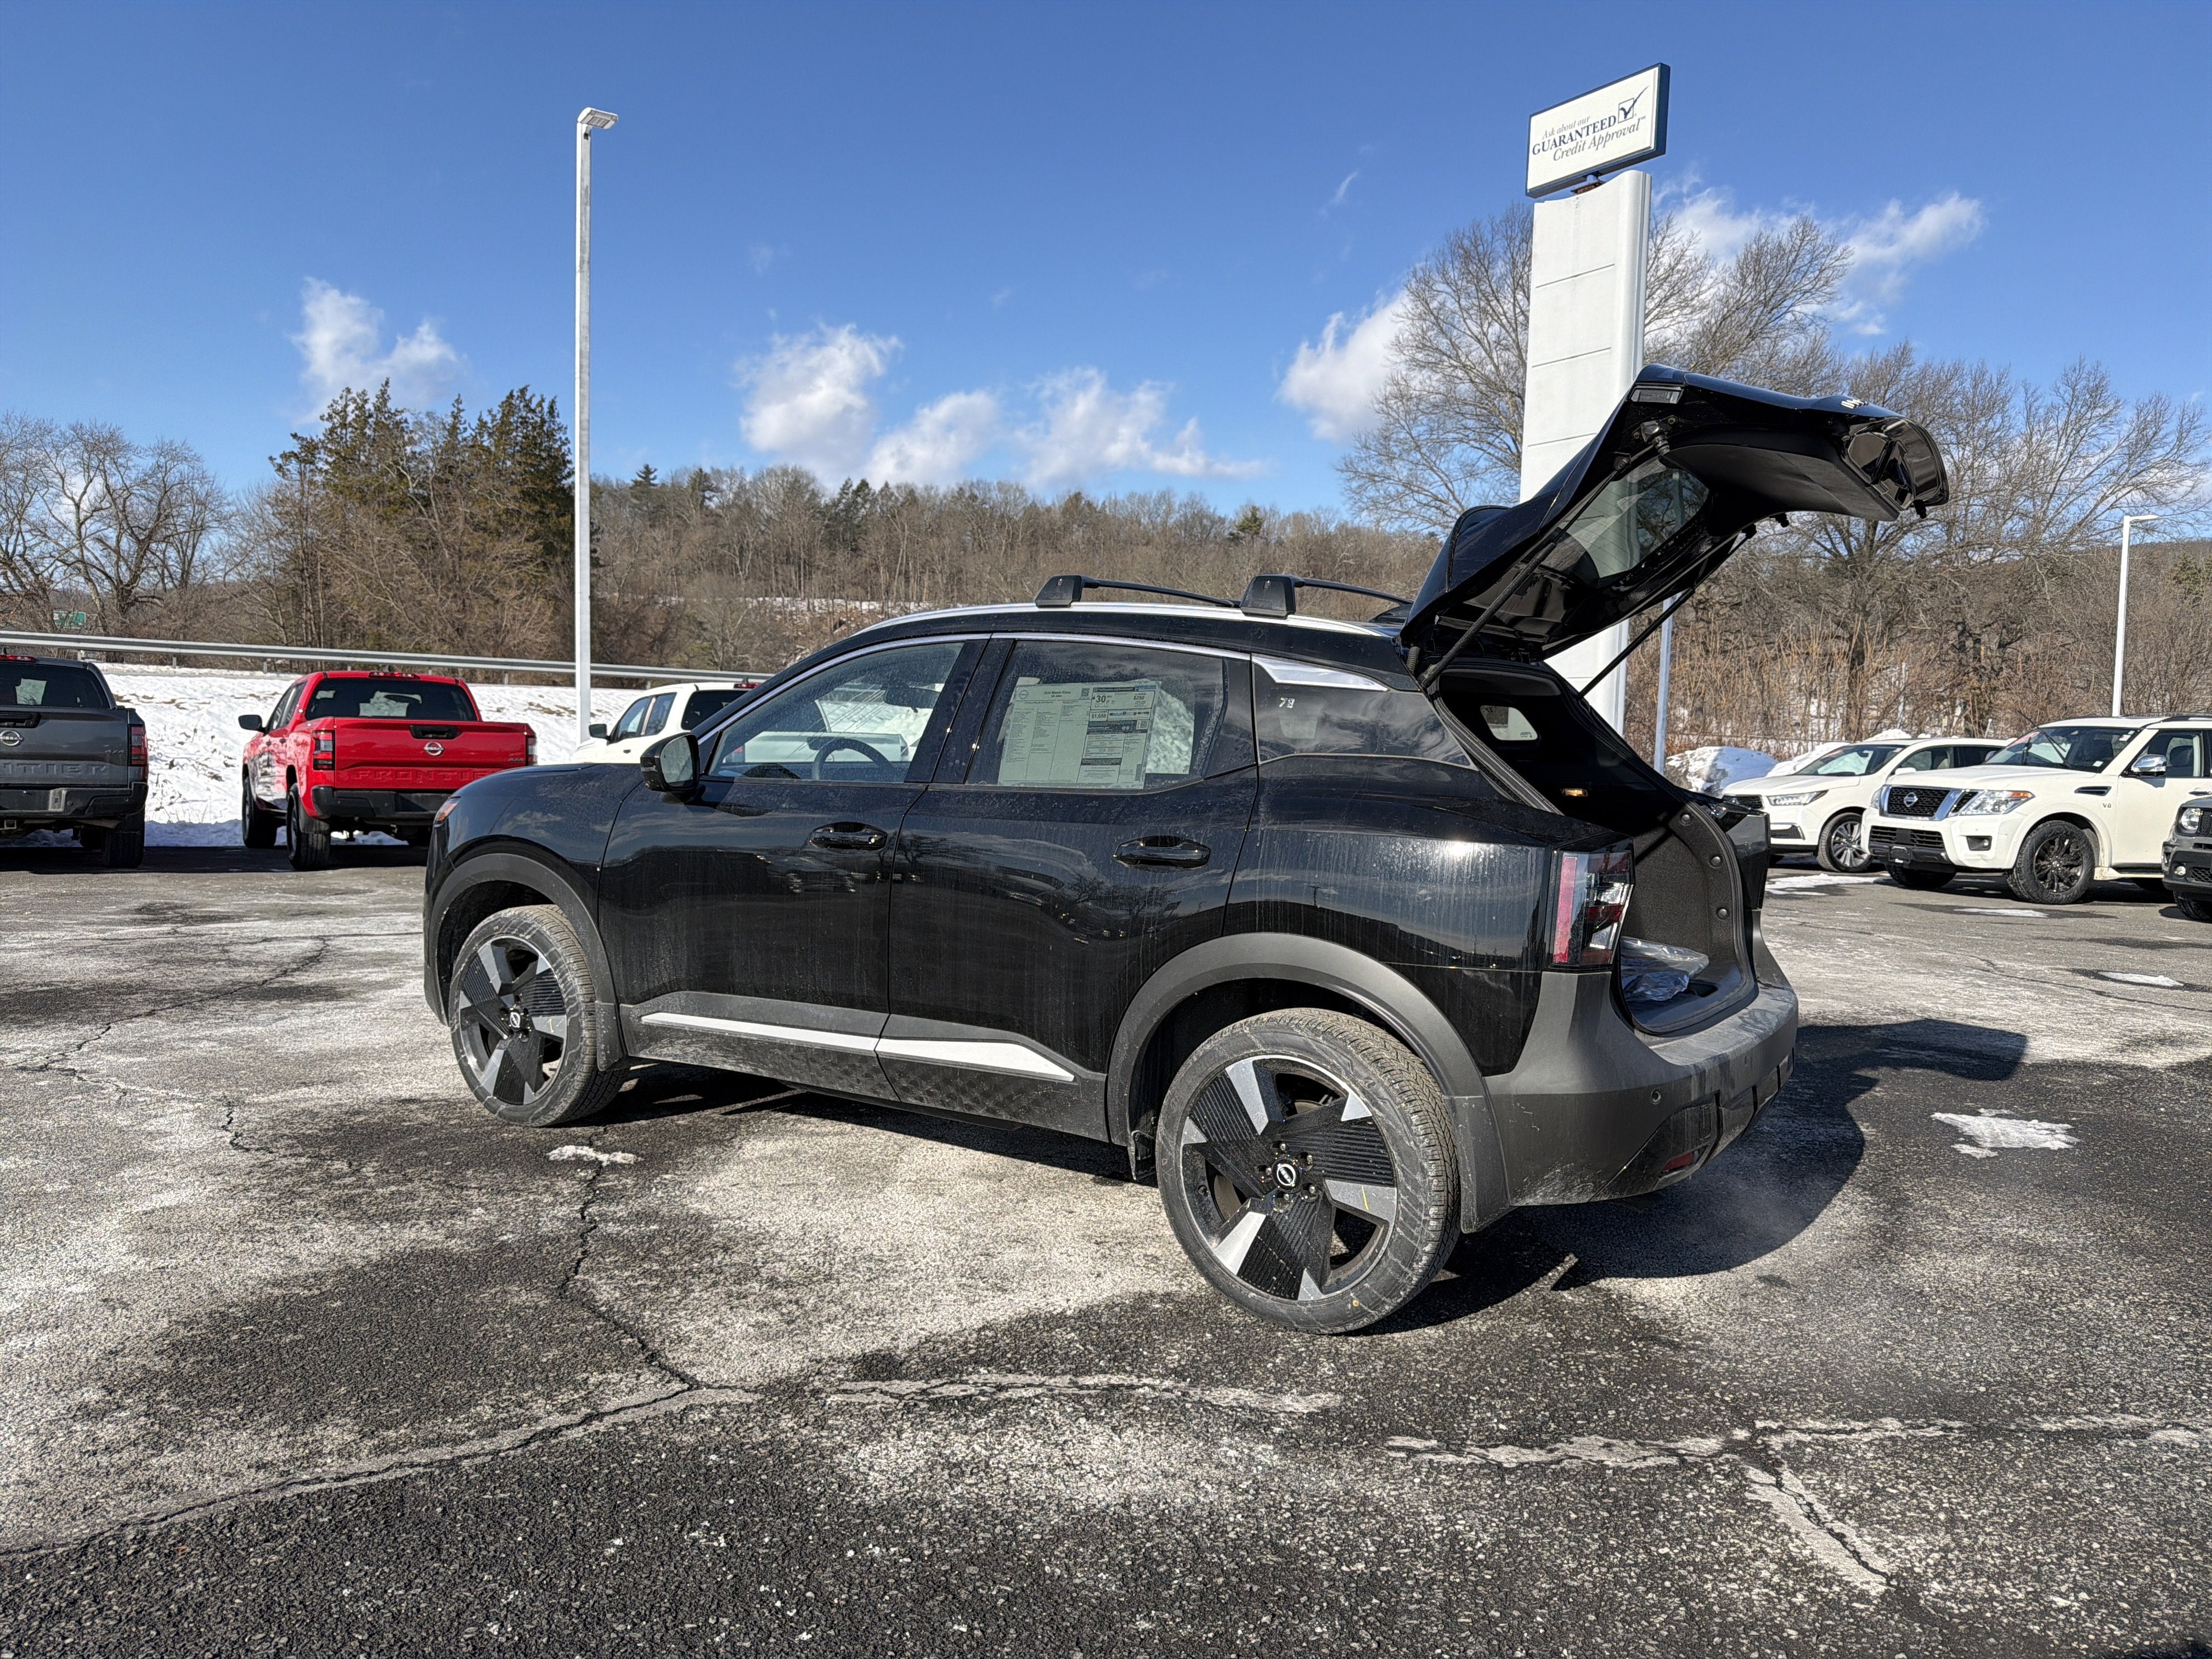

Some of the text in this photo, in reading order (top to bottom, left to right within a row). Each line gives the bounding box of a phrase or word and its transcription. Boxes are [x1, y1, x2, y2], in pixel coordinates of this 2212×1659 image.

[1532, 115, 1617, 155] GUARANTEED
[1542, 116, 1591, 140] Ask about our
[1553, 139, 1587, 161] Credit
[1096, 695, 1106, 703] 30
